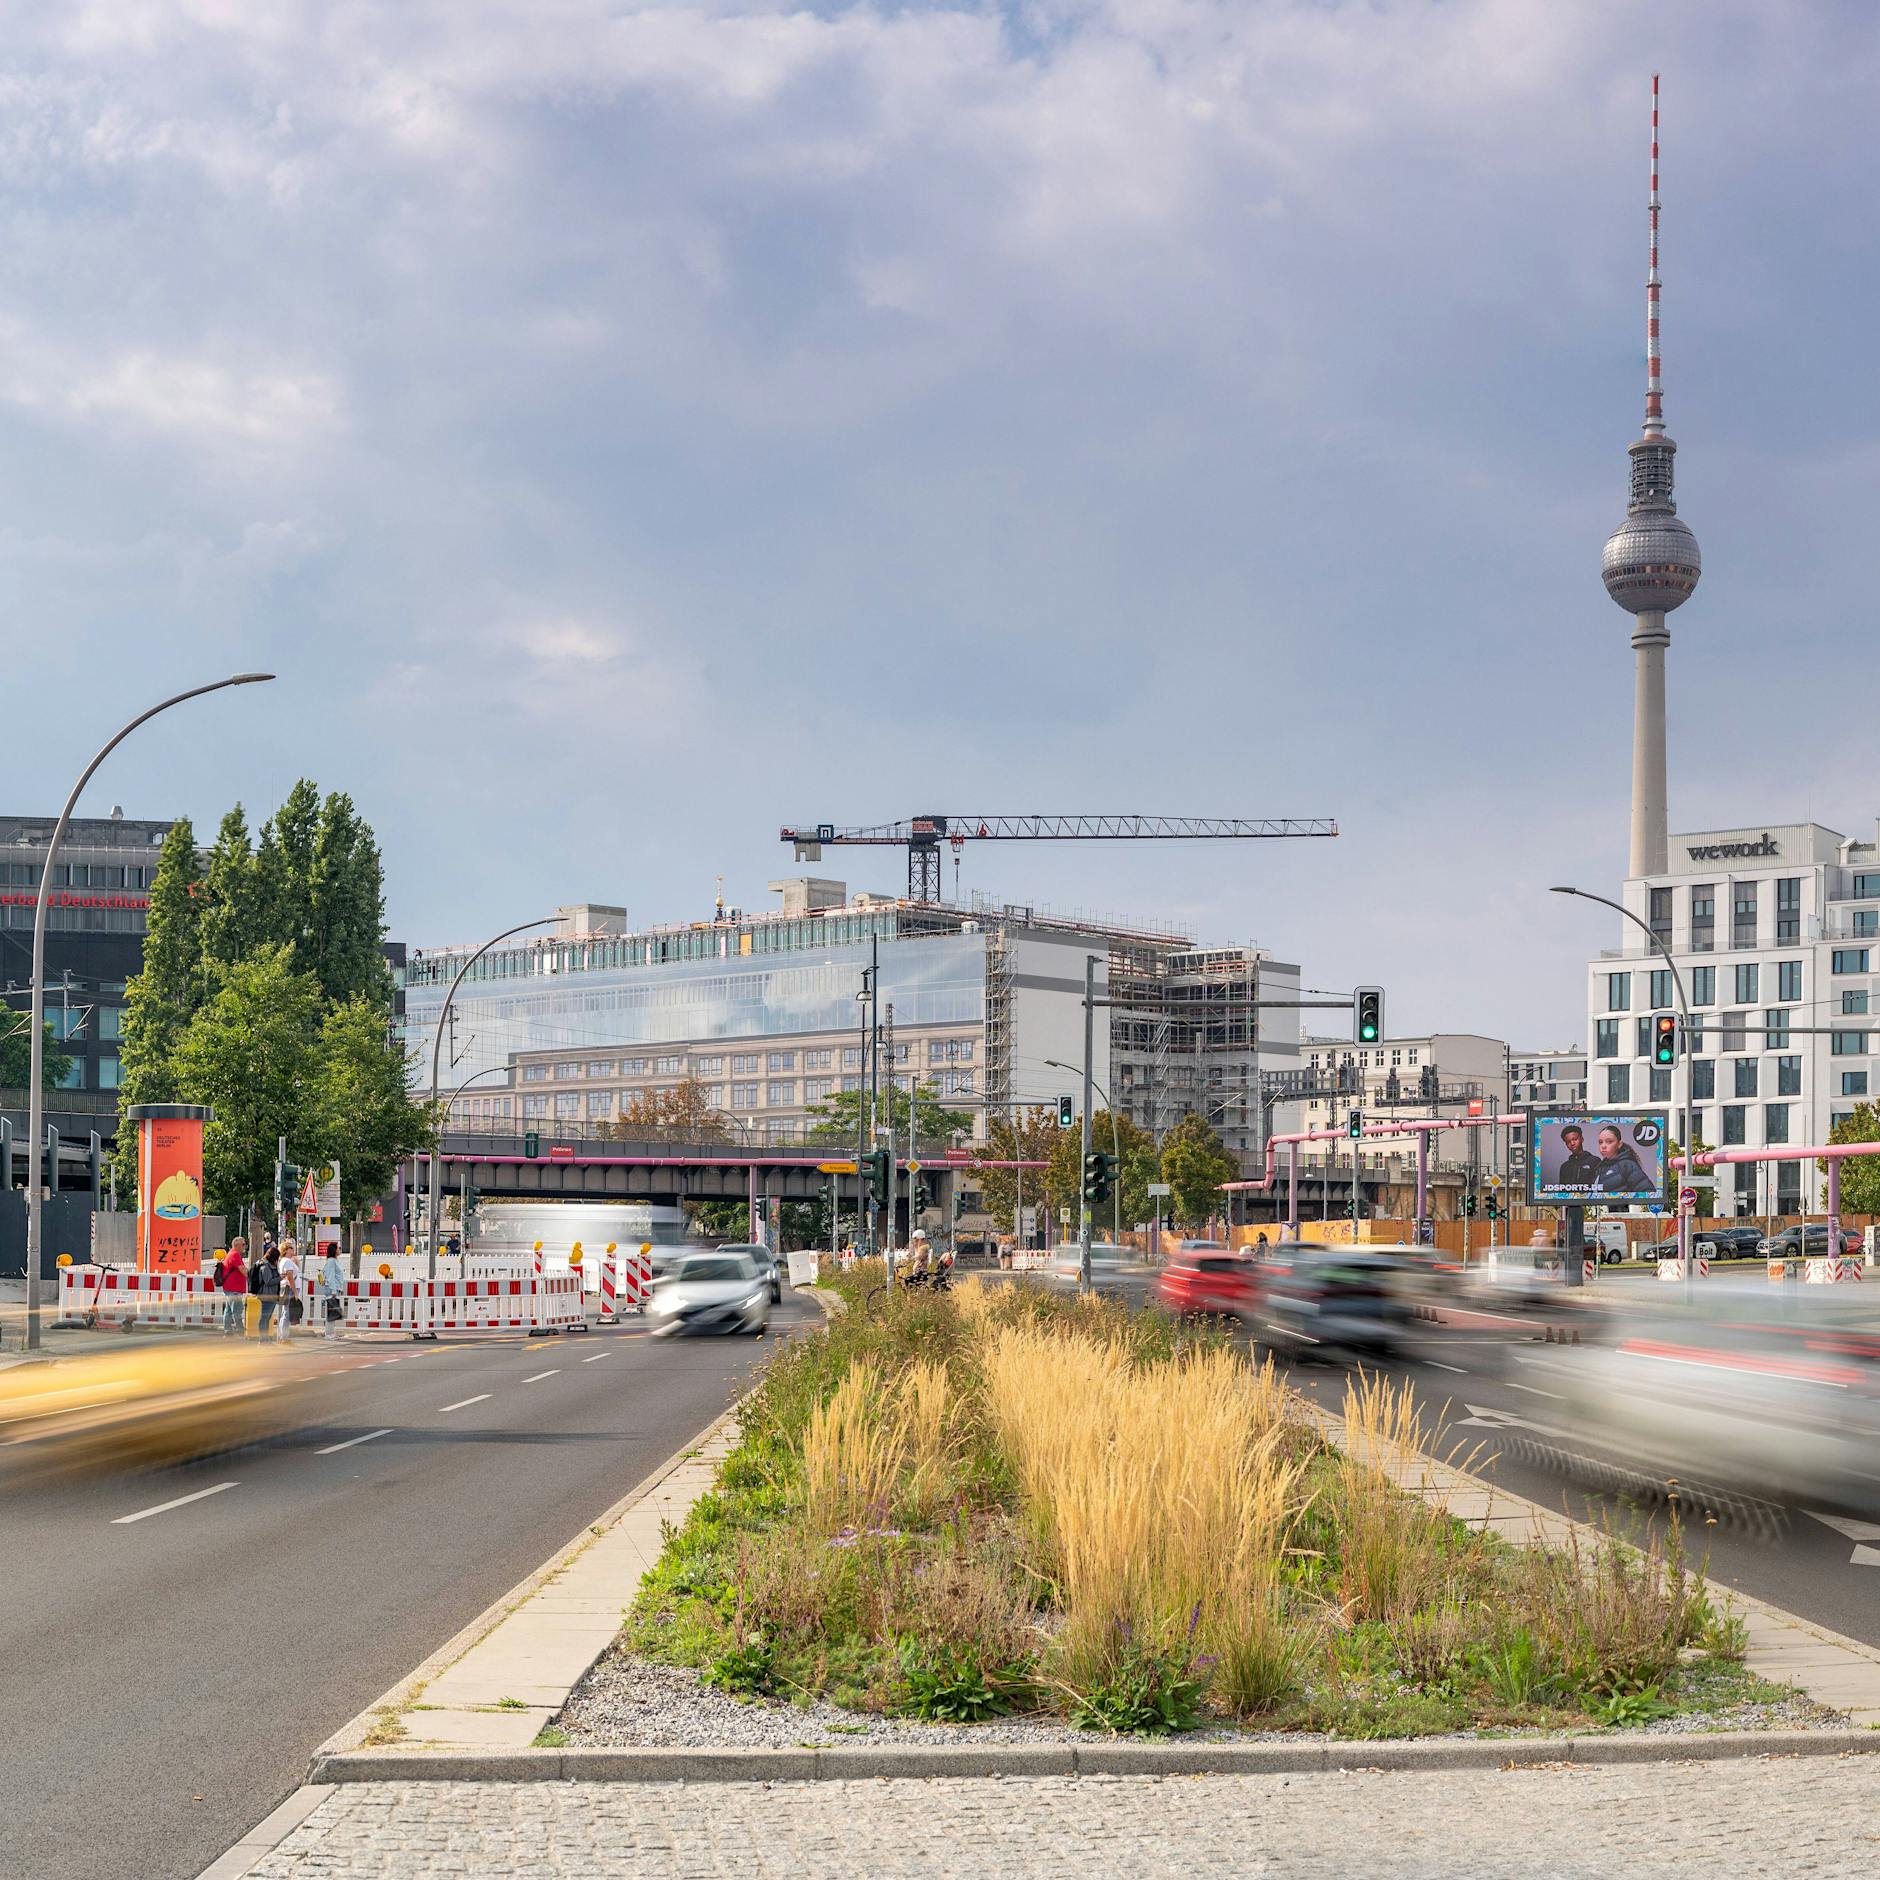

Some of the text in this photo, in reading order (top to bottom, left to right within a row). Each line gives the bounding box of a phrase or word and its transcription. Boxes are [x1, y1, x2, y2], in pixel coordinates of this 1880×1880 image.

[1686, 832, 1779, 861] wework
[1, 892, 149, 908] erbad Deutschlan
[1636, 1126, 1658, 1141] JD
[1542, 1183, 1604, 1192] JDSPORTS.DE
[1699, 1247, 1713, 1256] Bolt
